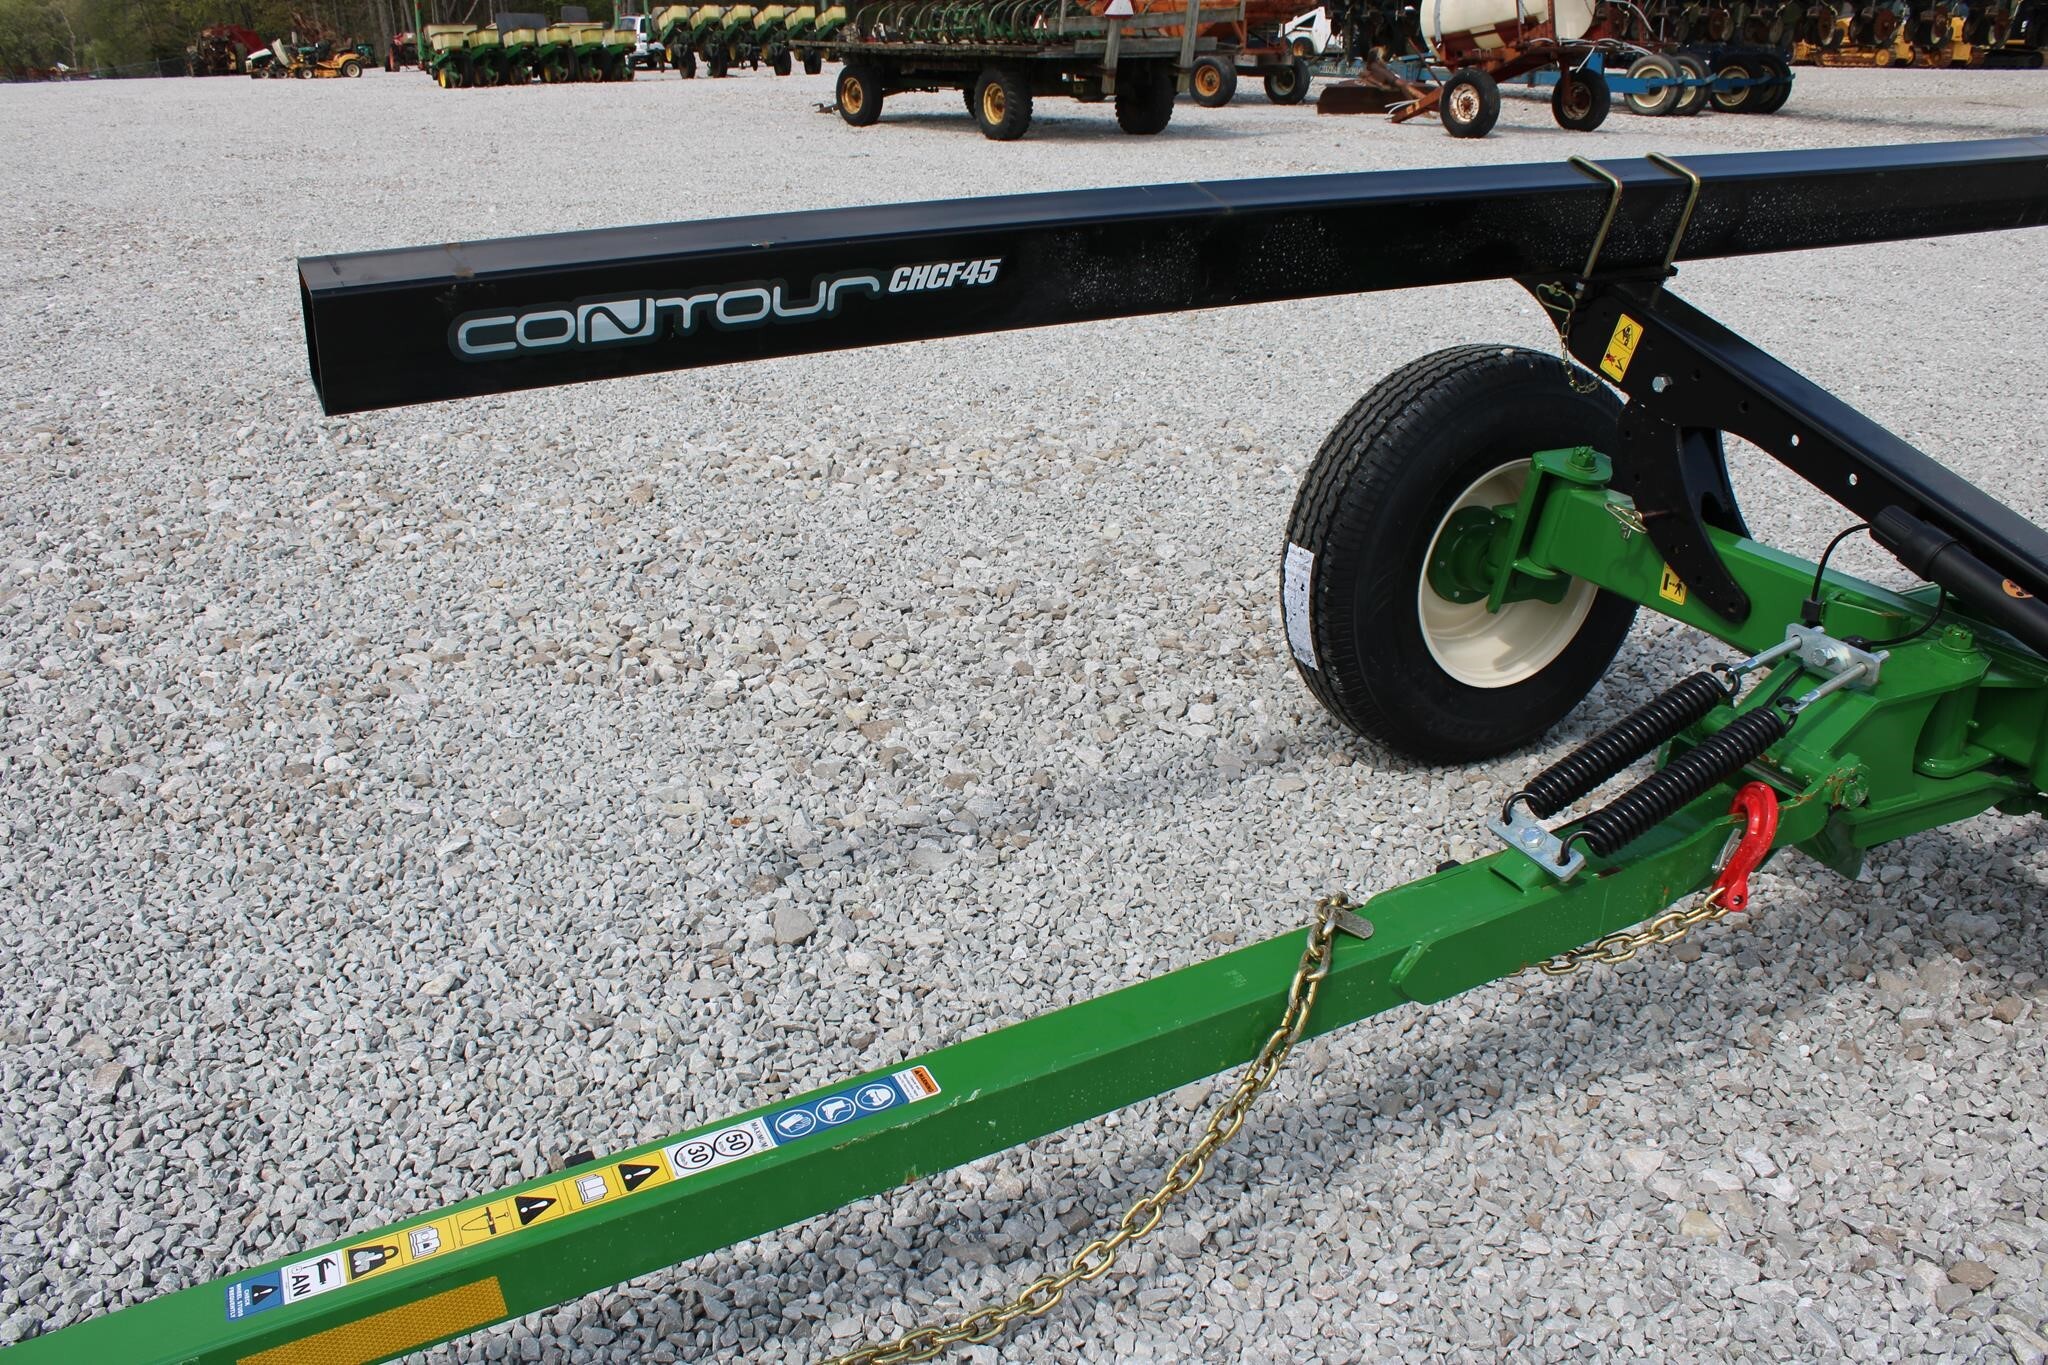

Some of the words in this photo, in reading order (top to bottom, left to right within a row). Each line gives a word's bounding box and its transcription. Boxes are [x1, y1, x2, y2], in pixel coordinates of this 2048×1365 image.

[888, 258, 1002, 293] CHCF45
[725, 1133, 747, 1151] 50
[751, 1121, 768, 1147] MAXIMUM
[687, 1145, 708, 1163] 30
[292, 1275, 311, 1296] AN
